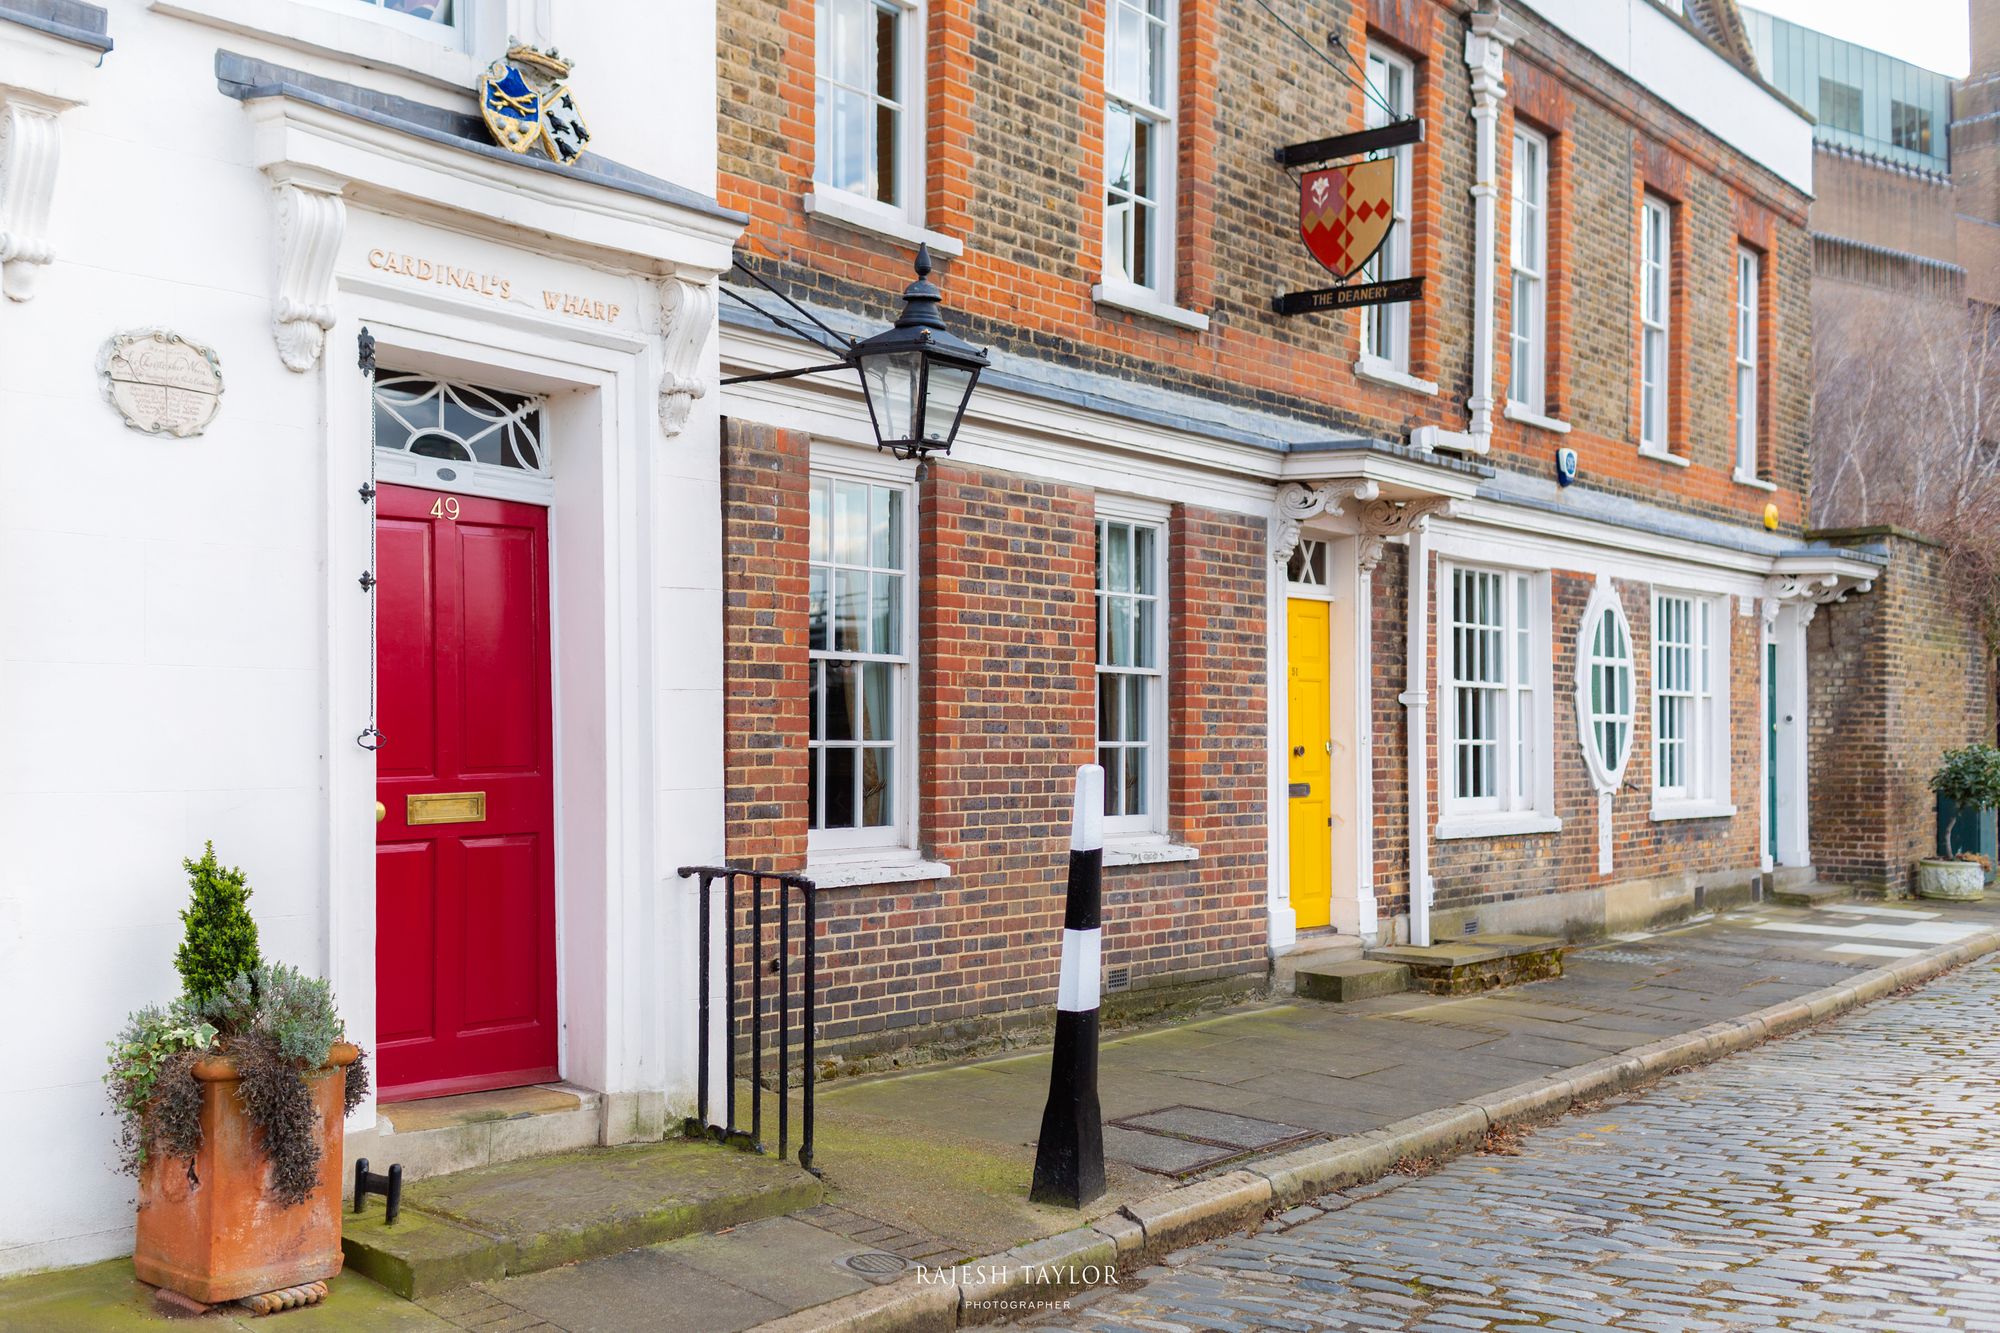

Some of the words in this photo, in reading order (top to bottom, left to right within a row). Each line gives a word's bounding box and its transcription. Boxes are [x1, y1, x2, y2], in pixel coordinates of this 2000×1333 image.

[368, 248, 512, 300] CARDINAL'S
[542, 289, 622, 323] WHARF
[1312, 292, 1333, 306] THE
[1338, 286, 1388, 303] DEANERY
[430, 496, 460, 520] 49
